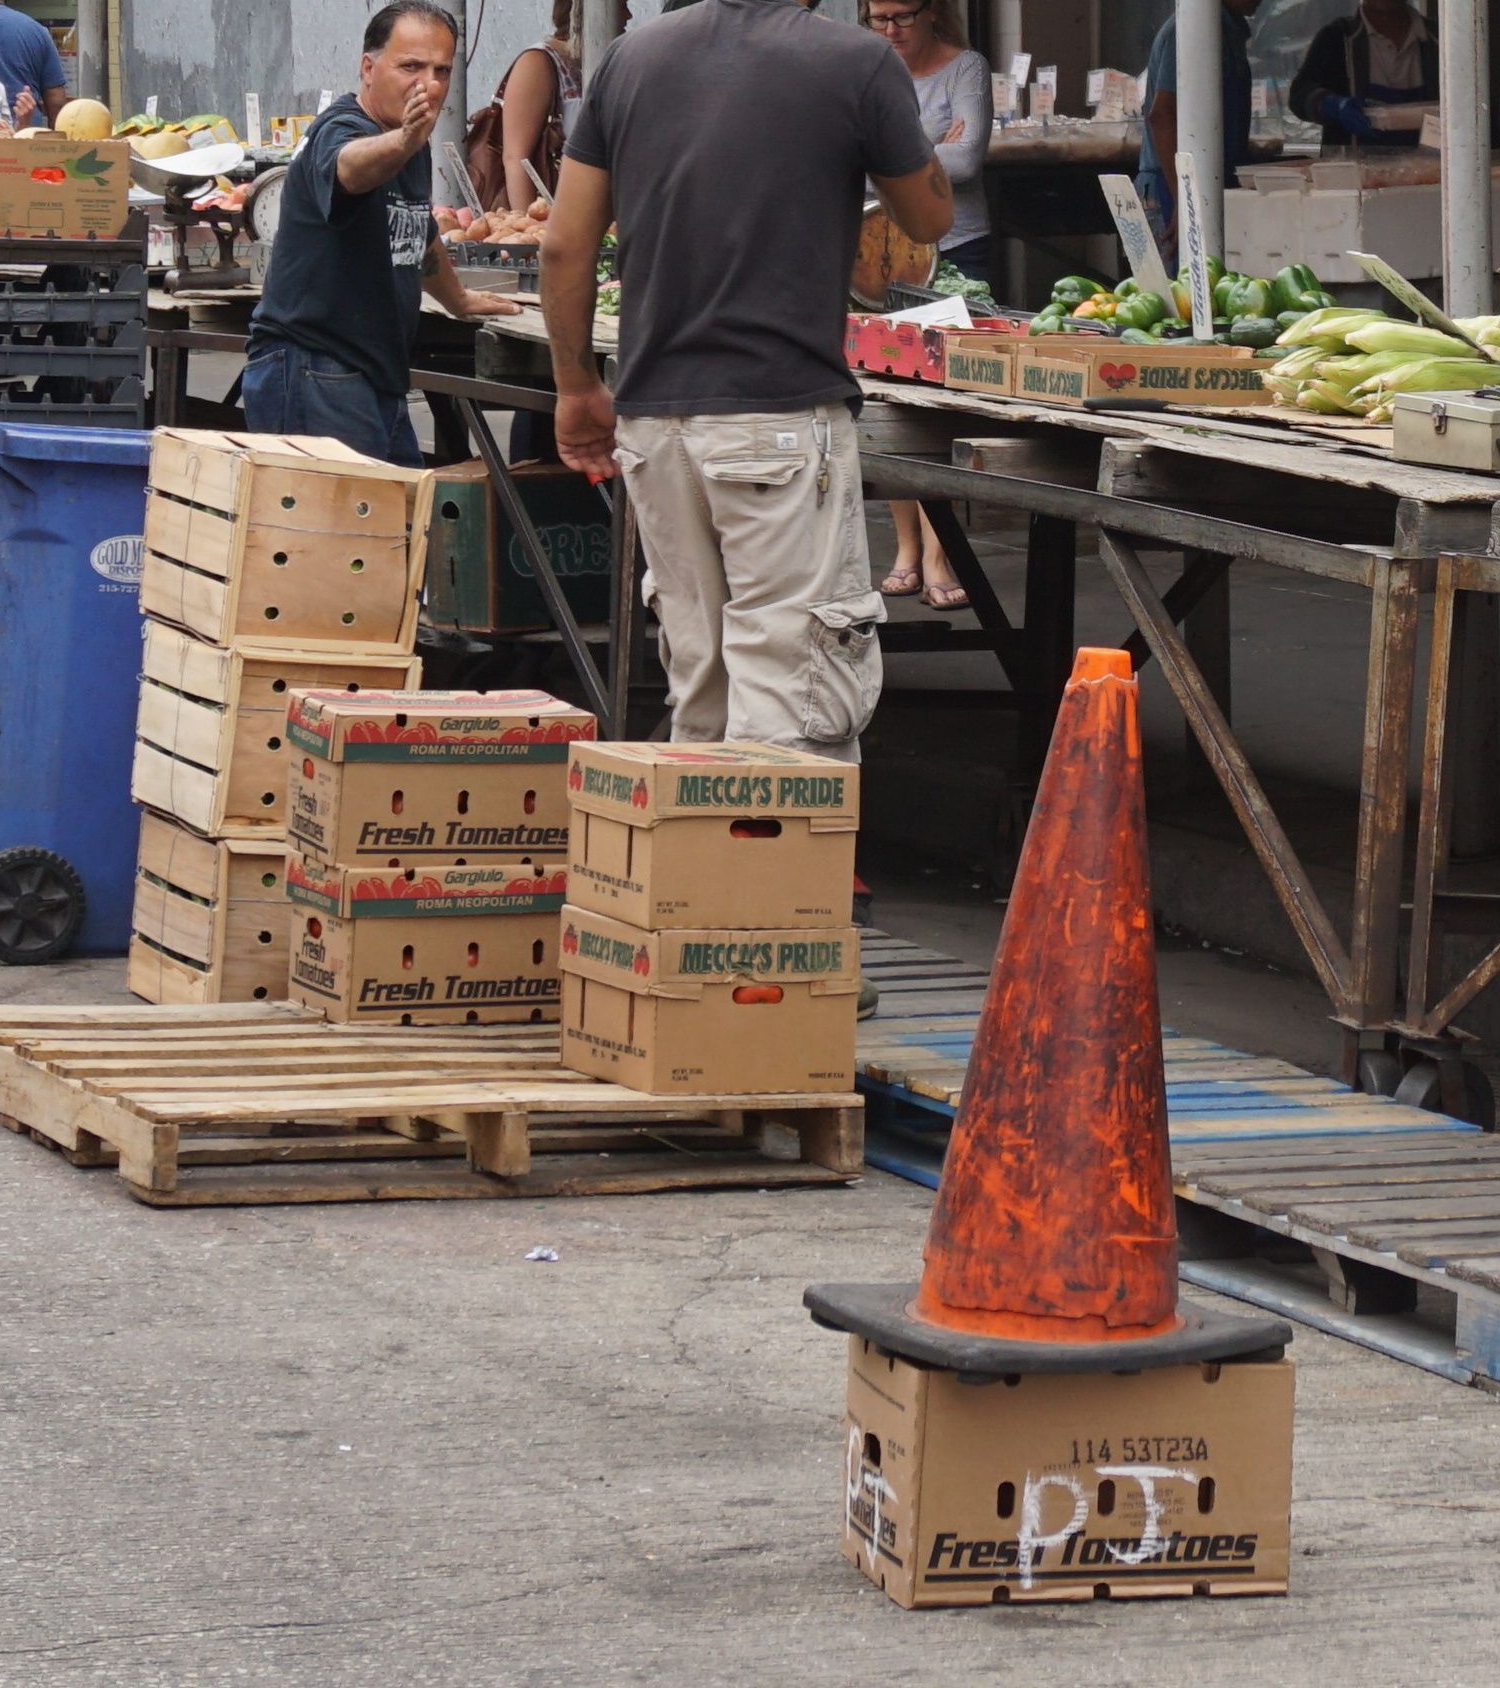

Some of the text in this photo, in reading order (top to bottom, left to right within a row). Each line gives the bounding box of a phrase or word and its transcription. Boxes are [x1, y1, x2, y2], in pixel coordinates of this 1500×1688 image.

[1140, 366, 1189, 389] PRIDE
[96, 539, 128, 565] GOLD
[108, 566, 141, 575] DISPO
[98, 584, 138, 593] 215-727
[440, 717, 500, 733] Gargiulo
[410, 744, 529, 756] ROMA NEOPOLITAN
[584, 765, 633, 803] MECCA'S PRIDE
[676, 775, 845, 808] MECCA'S PRIDE
[357, 821, 436, 846] Fresh
[444, 870, 504, 886] Gargiulo
[416, 895, 533, 910] ROMA NEOPOLITAN
[301, 932, 326, 963] Fresh
[579, 930, 635, 971] MECCA'S PRIDE
[678, 941, 843, 974] MECCA'S PRIDE
[294, 951, 335, 990] Tomatoes
[358, 977, 435, 1002] Fresh
[1070, 1436, 1209, 1464] 114 53T23A
[928, 1530, 1258, 1569] Fresh Tomatoes
